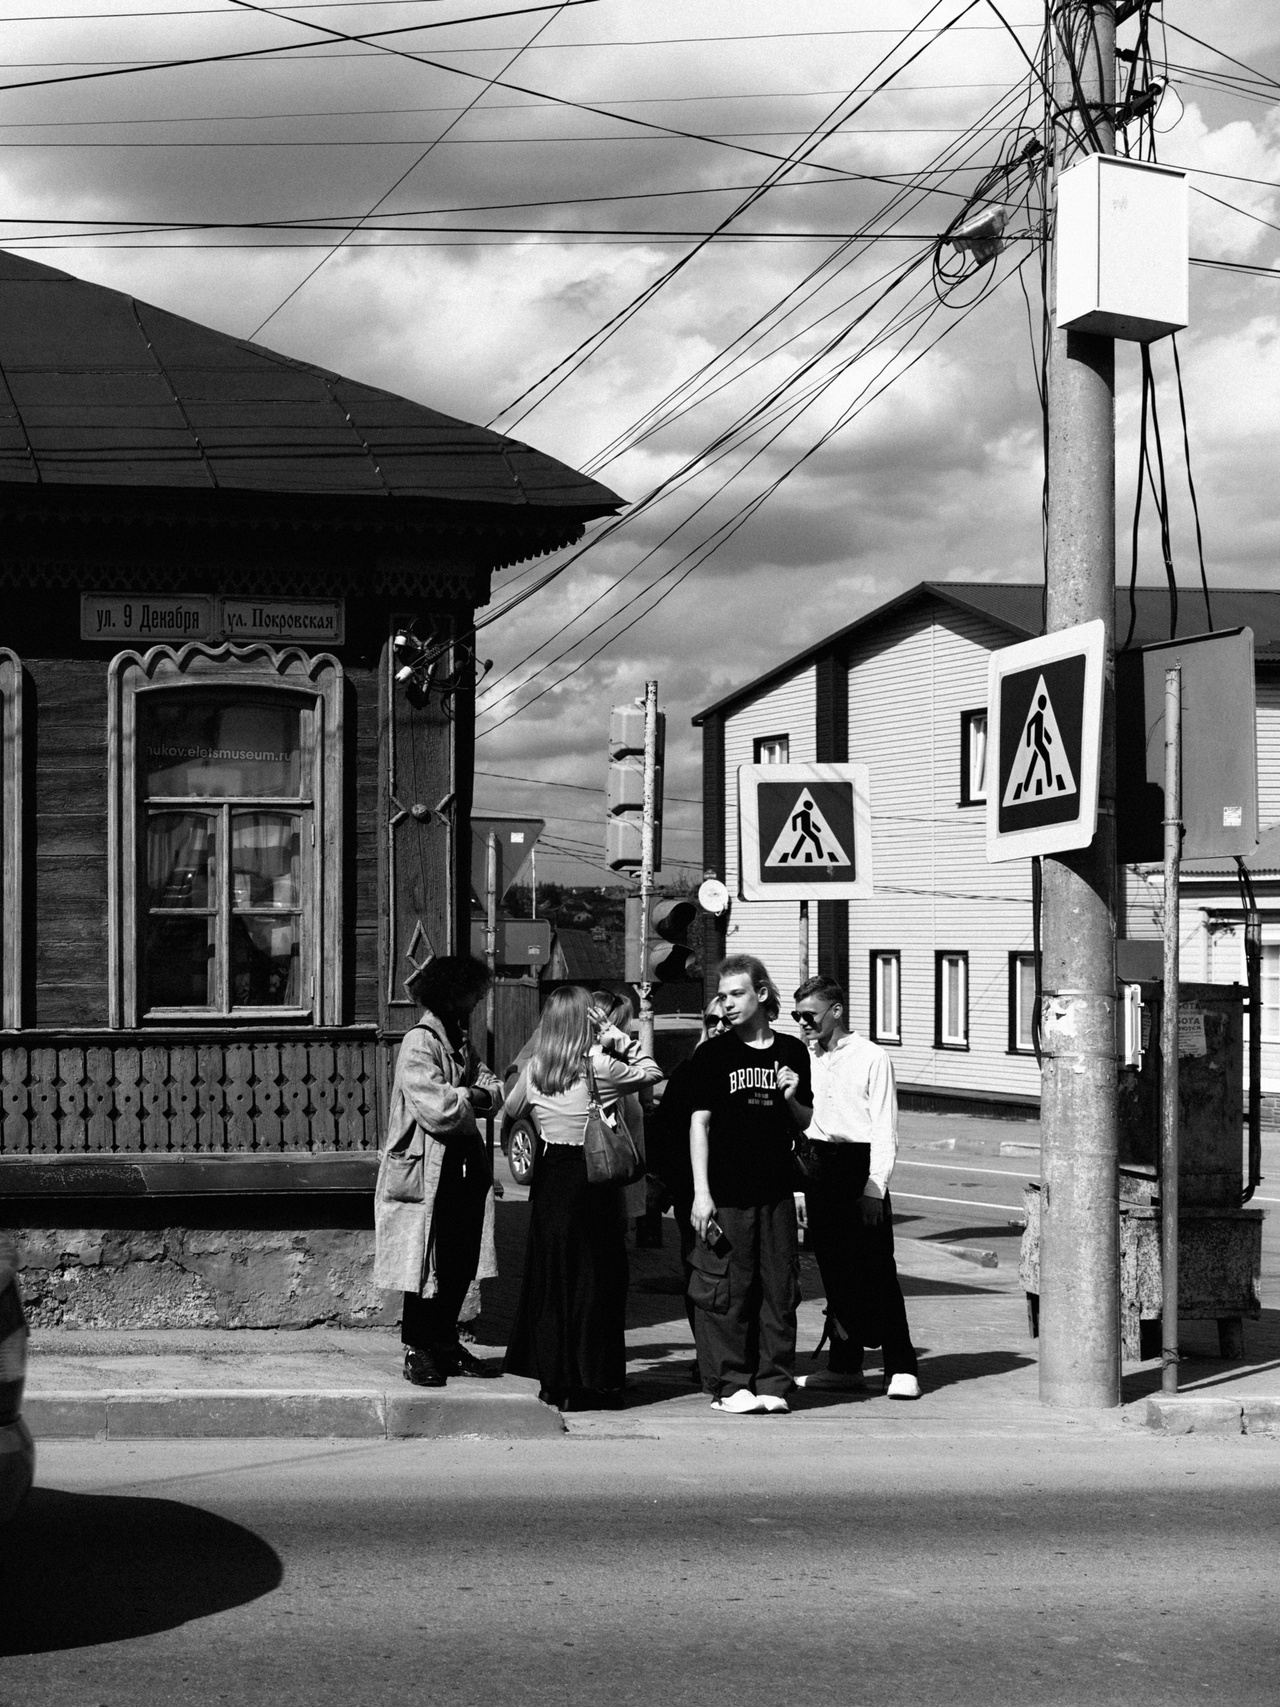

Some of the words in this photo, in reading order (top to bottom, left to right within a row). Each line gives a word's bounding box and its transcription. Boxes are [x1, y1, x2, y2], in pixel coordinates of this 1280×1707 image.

[97, 608, 115, 632] ул.
[124, 604, 132, 628] 9
[140, 604, 200, 632] Декабря
[227, 613, 247, 632] ул.
[252, 608, 333, 633] Покровская
[146, 743, 291, 762] ukov.eletsmuseum.ru
[729, 1067, 776, 1094] BROOKL
